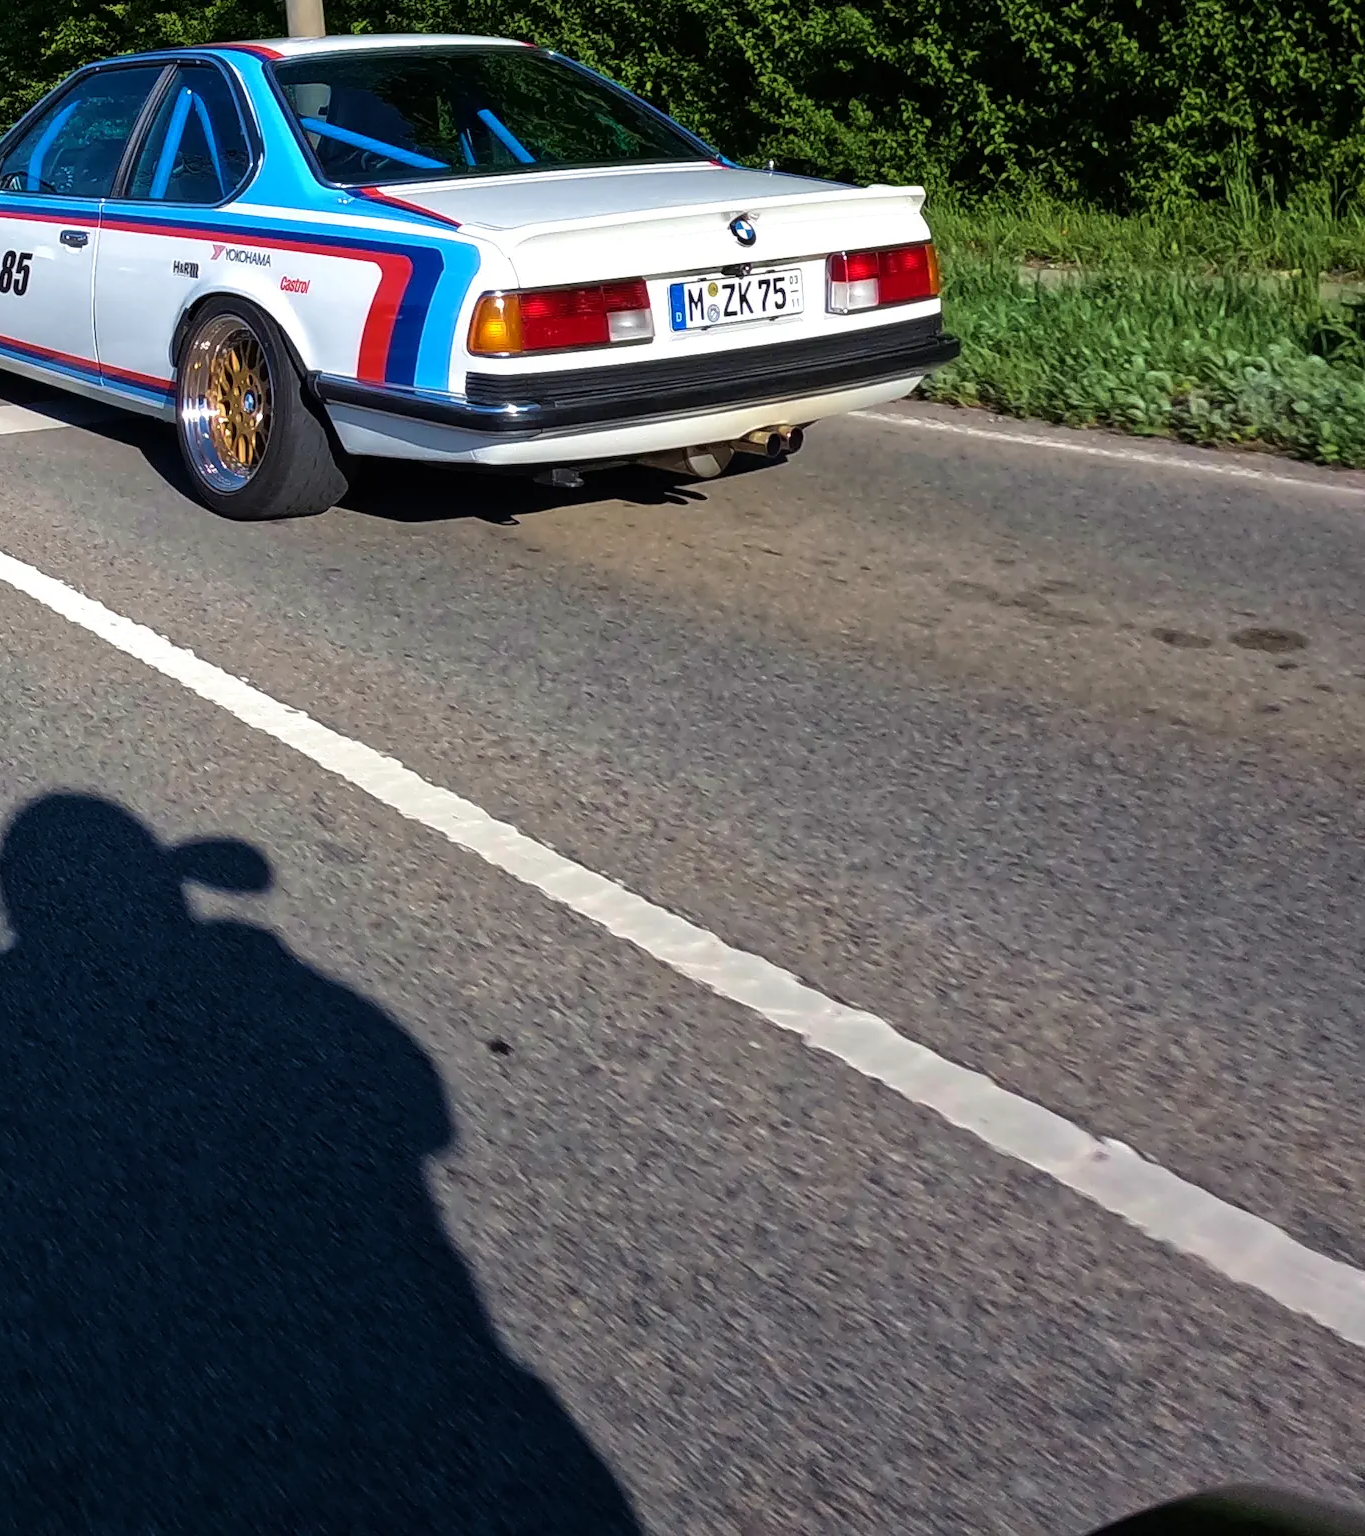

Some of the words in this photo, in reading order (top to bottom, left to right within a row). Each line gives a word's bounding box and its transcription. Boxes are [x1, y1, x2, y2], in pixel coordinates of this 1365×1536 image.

[225, 248, 271, 267] YOKOHAMA
[280, 276, 311, 294] Castrol
[688, 287, 704, 321] M
[722, 281, 753, 316] ZK
[758, 277, 787, 309] 75
